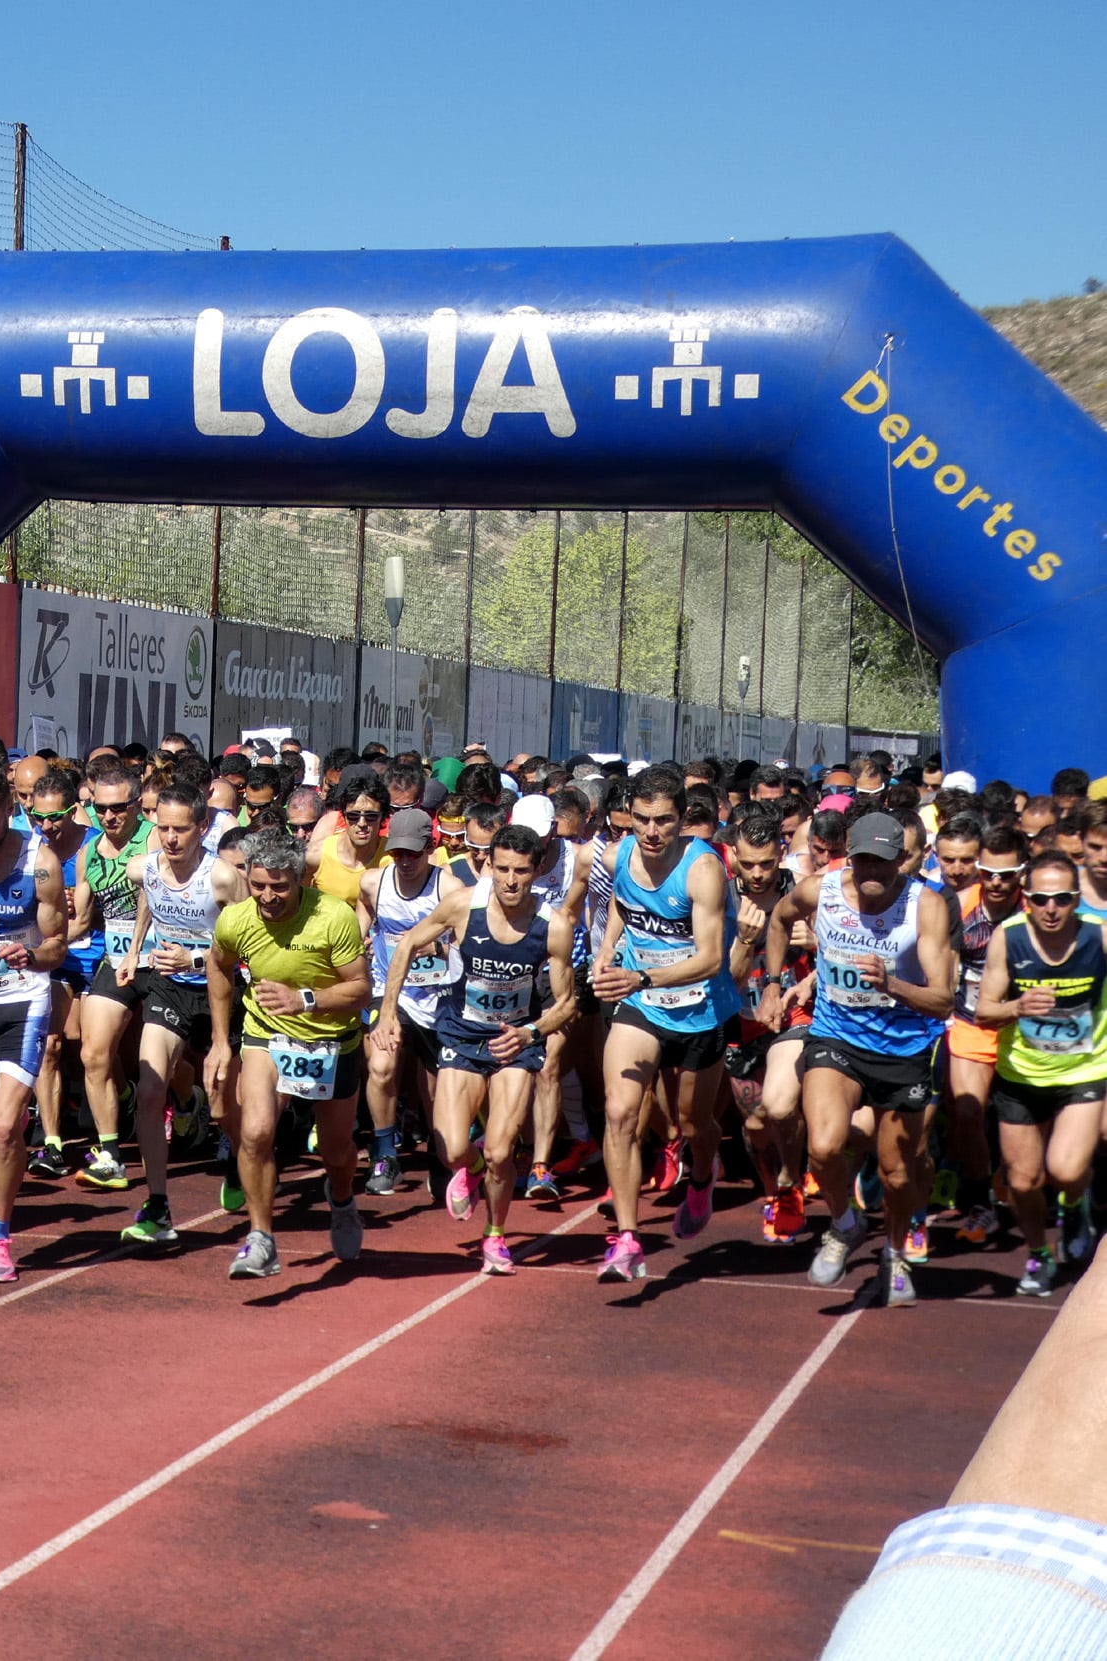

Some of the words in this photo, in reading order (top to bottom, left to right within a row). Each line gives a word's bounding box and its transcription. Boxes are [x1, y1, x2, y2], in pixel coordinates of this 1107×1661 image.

[193, 305, 577, 438] LOJA
[841, 370, 1062, 581] Deportes
[95, 612, 165, 675] Talleres
[224, 650, 285, 701] García
[287, 656, 343, 708] Lizana
[183, 702, 208, 718] ŠKODA
[153, 903, 205, 917] MARACENA
[827, 930, 899, 952] MARACENA
[476, 993, 519, 1010] 461
[1031, 1019, 1080, 1038] 773
[279, 1055, 324, 1078] 283
